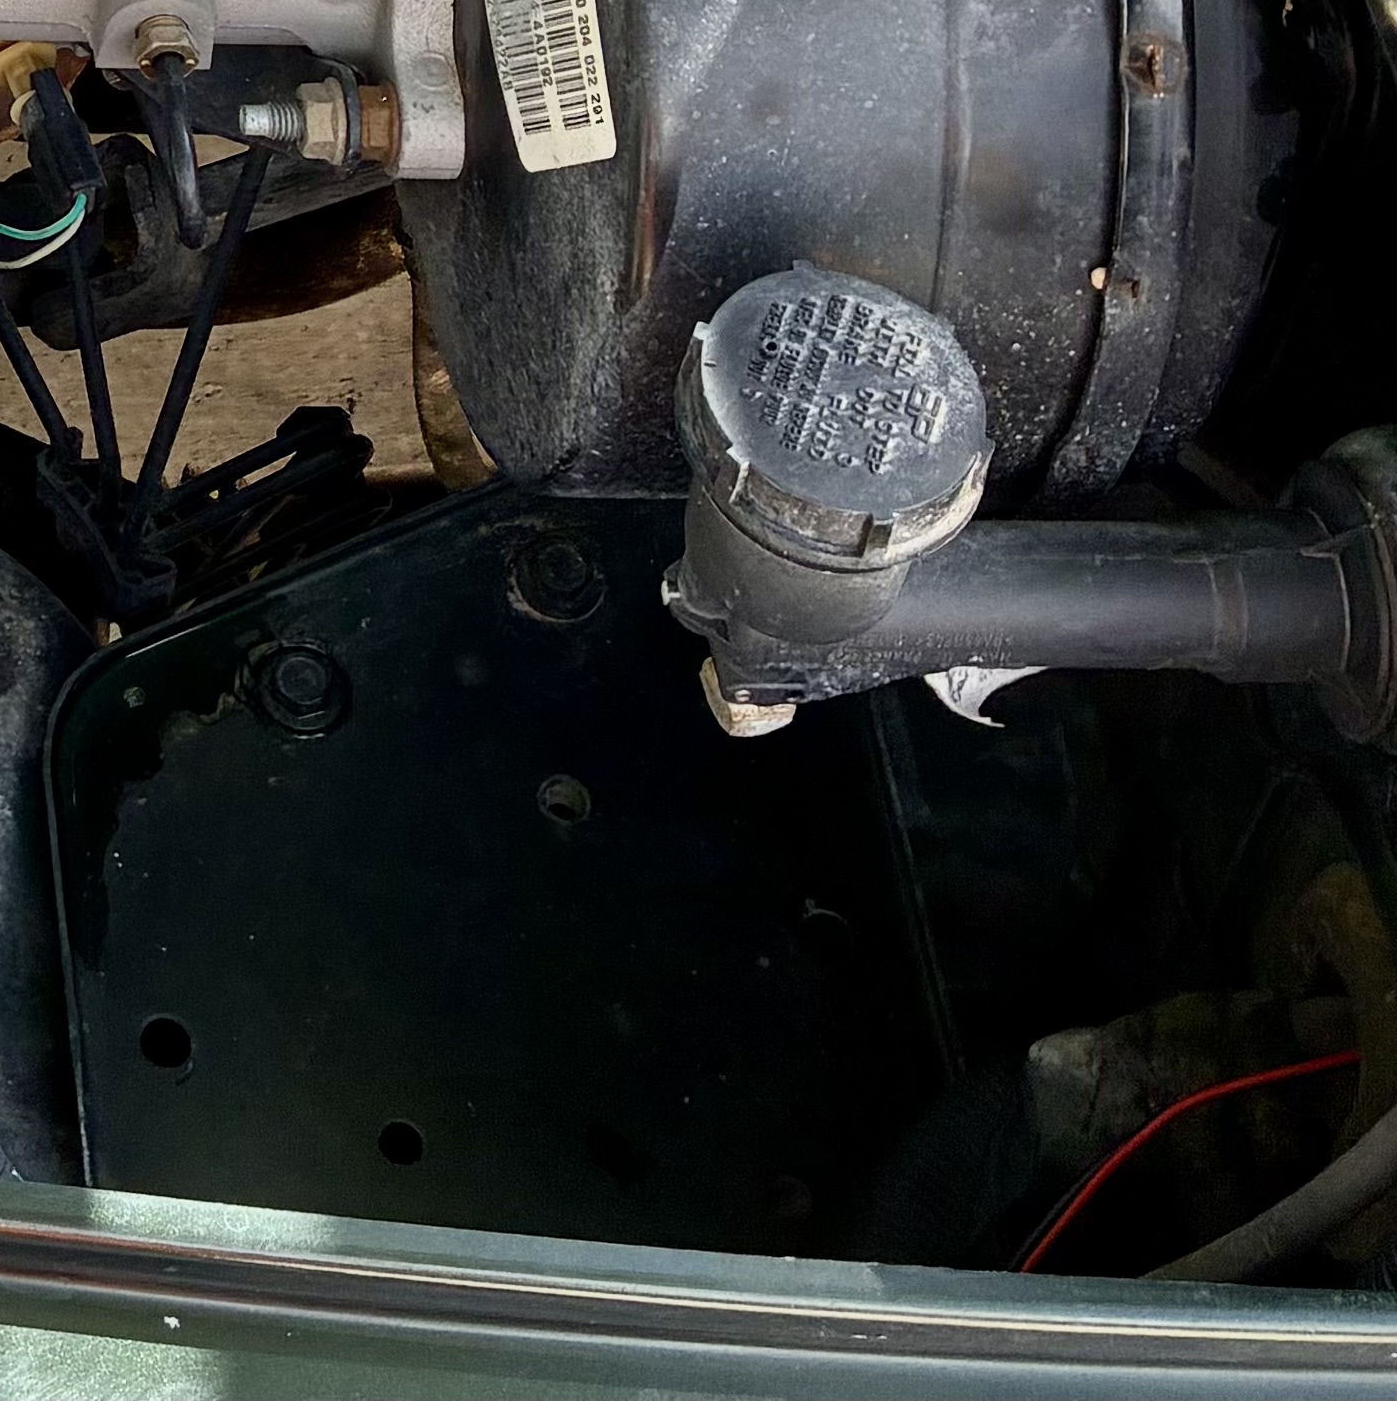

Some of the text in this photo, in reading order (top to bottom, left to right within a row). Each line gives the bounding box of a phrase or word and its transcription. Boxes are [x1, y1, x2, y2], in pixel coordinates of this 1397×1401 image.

[577, 14, 593, 47] 204
[584, 54, 599, 87] 022
[591, 93, 605, 125] 201
[837, 301, 876, 367] BRAKE
[804, 391, 846, 462] FLUID
[859, 417, 898, 476] STEP
